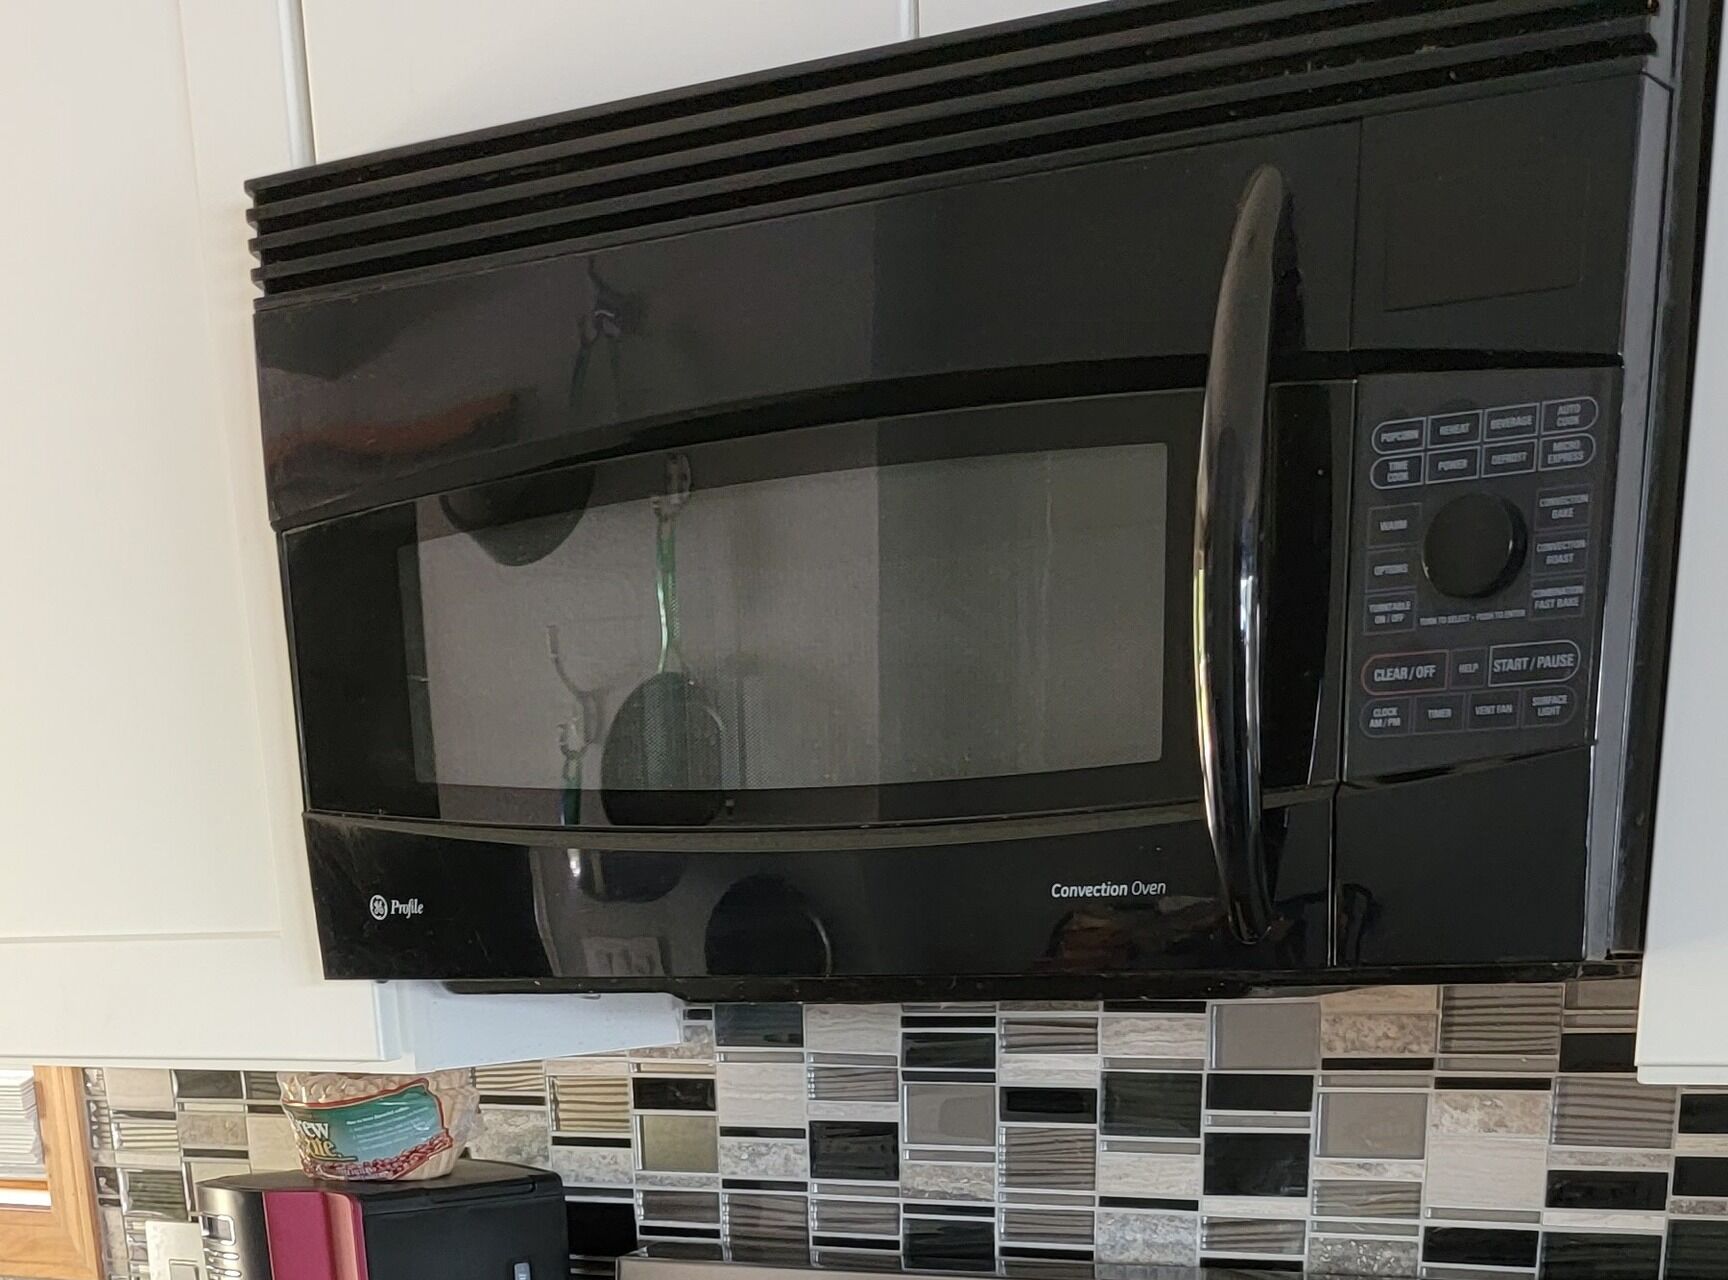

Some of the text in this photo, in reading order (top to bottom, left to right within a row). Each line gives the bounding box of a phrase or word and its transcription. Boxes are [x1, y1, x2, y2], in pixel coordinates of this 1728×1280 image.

[1458, 663, 1479, 674] HELP
[1492, 657, 1529, 673] START
[1537, 653, 1575, 668] PAUSE
[1373, 667, 1408, 682] CLEAR
[1415, 664, 1437, 679] OFF
[1051, 880, 1167, 898] Convection Oven
[391, 898, 424, 919] Profile
